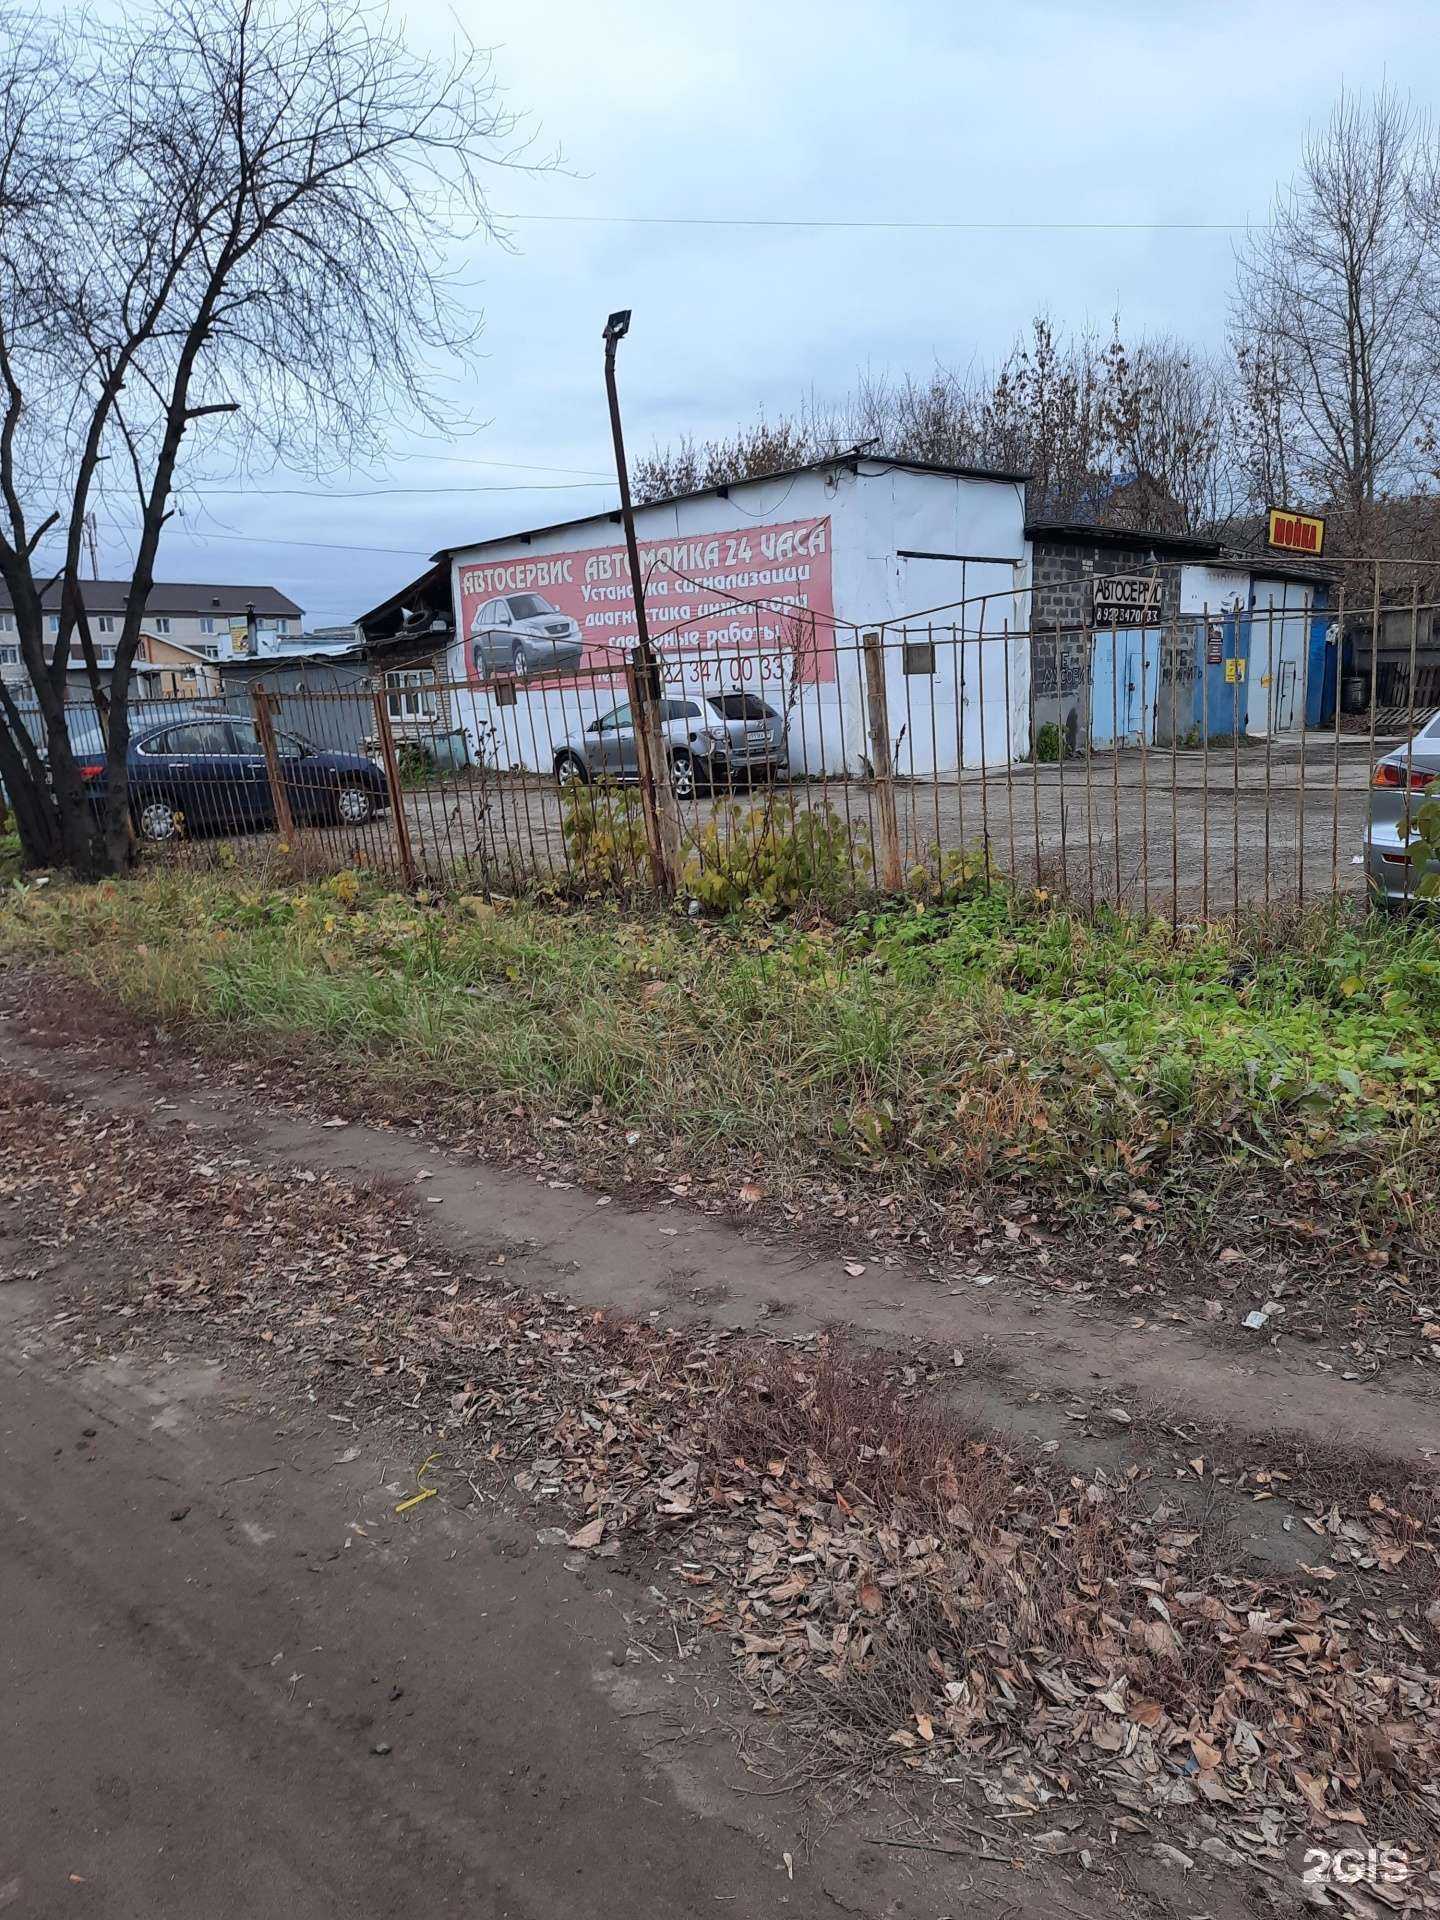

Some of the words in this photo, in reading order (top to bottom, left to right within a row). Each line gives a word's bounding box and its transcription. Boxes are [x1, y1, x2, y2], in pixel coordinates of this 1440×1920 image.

[725, 537, 753, 566] 24
[760, 526, 826, 561] ЧАСА
[1273, 516, 1317, 550] МОЙКА
[463, 559, 573, 596] АВТОСЕРВИС
[608, 629, 700, 650] слесрные
[730, 657, 753, 681] 00
[760, 656, 783, 681] 33
